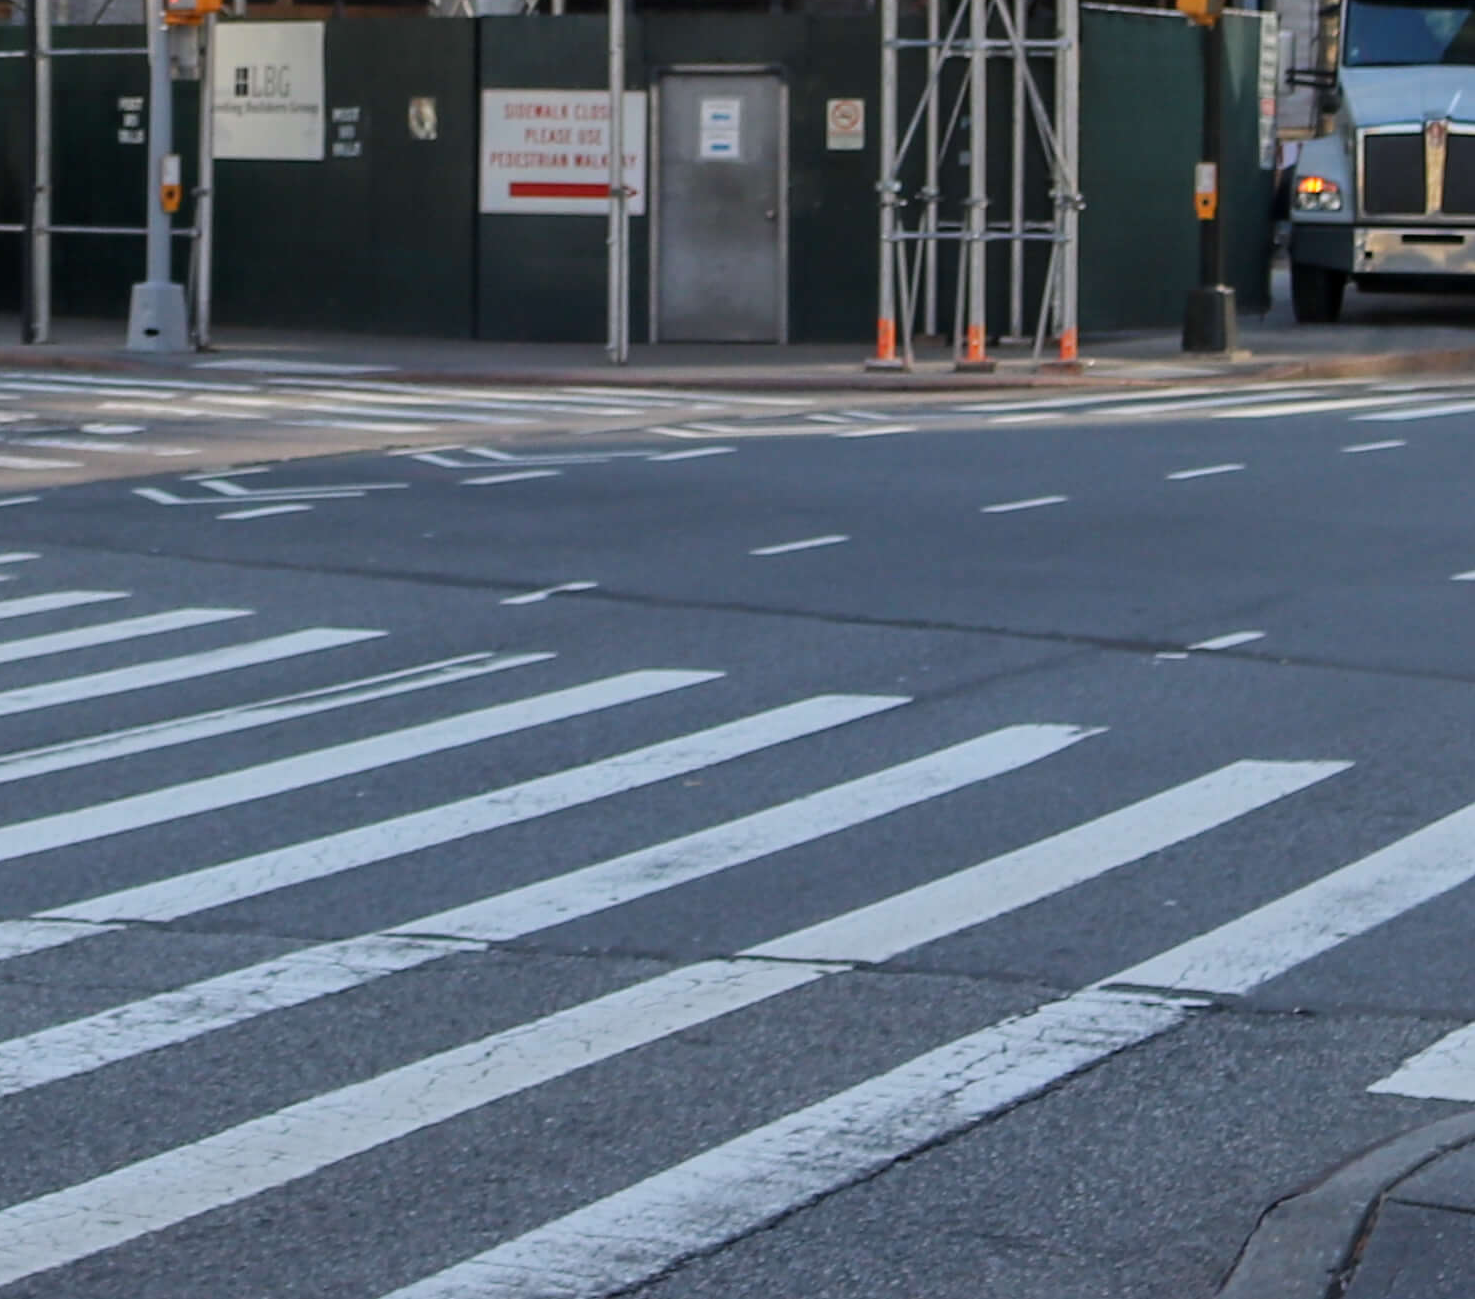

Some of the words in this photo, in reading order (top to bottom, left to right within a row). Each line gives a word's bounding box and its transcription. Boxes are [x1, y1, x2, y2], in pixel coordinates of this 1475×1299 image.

[252, 65, 291, 98] LBG
[504, 104, 568, 120] SIDEWALK
[574, 104, 613, 120] CLOS
[524, 128, 572, 144] PLEASE
[578, 129, 602, 145] USE
[490, 152, 568, 168] PEDESTRIAN
[574, 153, 636, 169] WALKY
